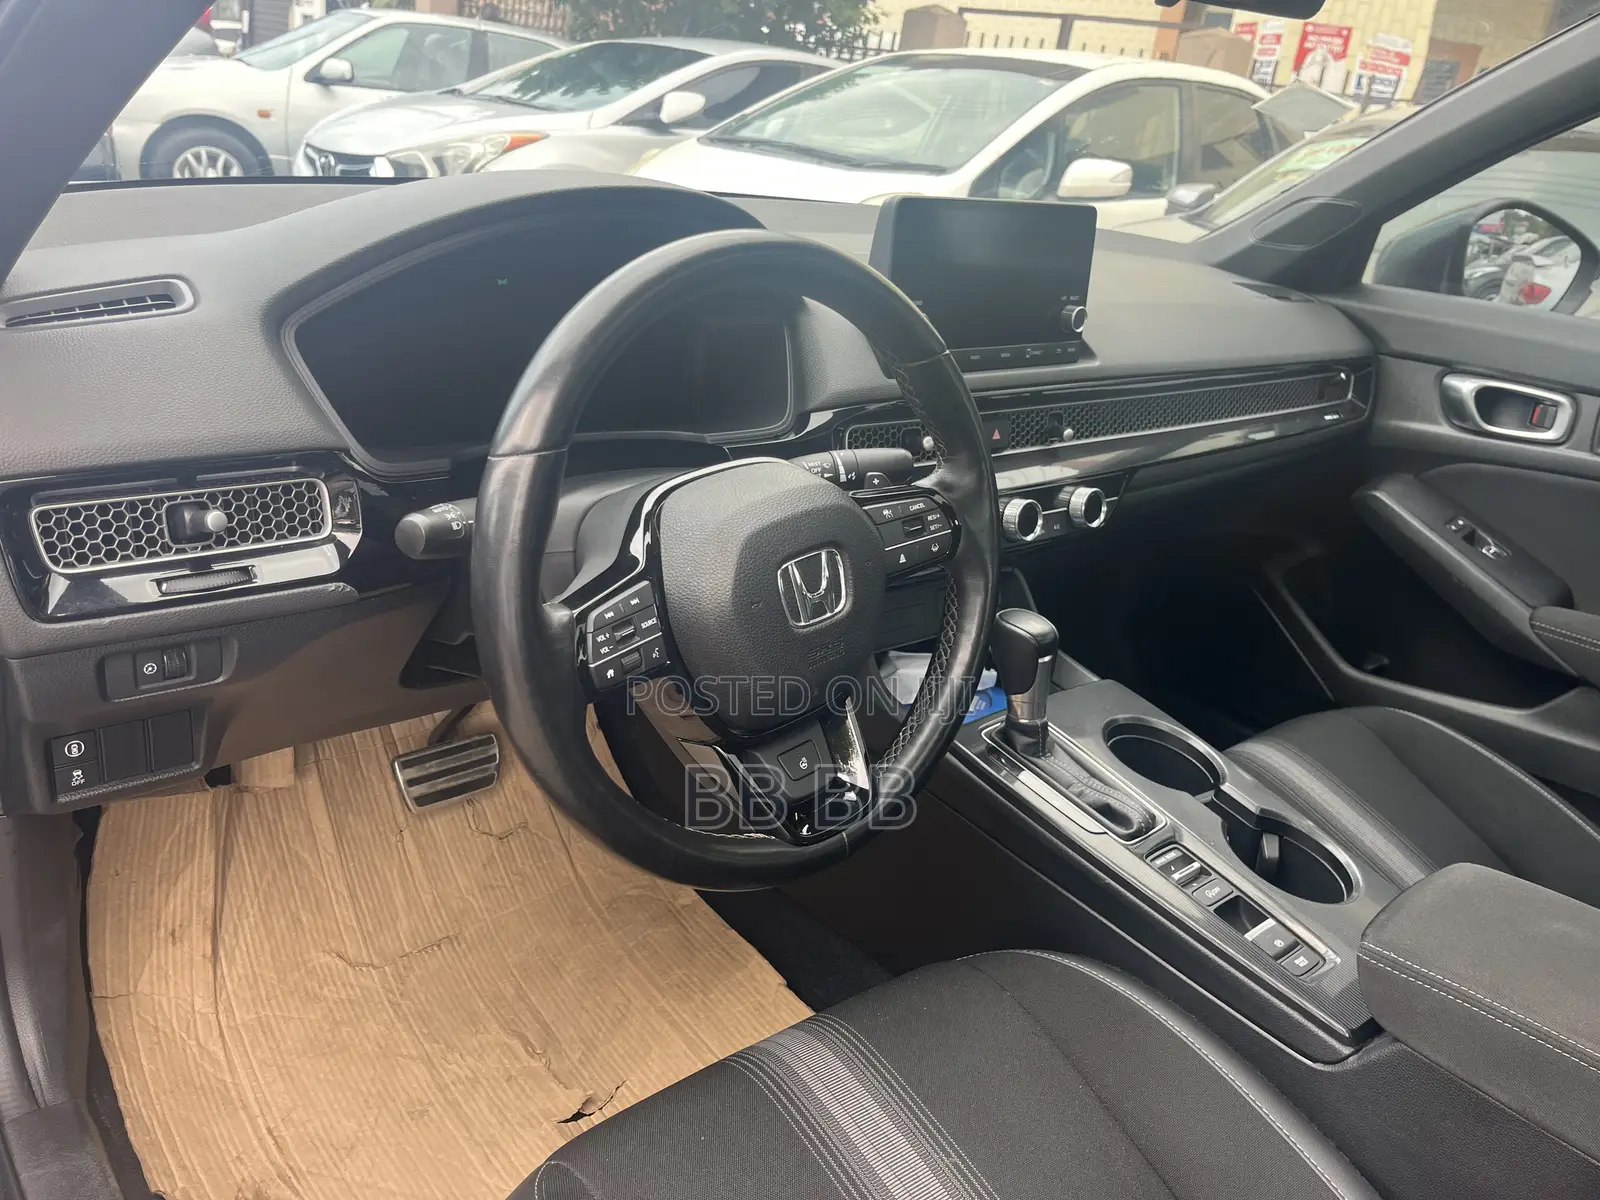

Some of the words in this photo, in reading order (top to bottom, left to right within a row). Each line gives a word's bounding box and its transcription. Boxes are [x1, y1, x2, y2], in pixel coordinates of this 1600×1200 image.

[909, 502, 926, 511] CANCEL
[641, 617, 657, 629] SOURCE
[71, 778, 86, 787] OFF
